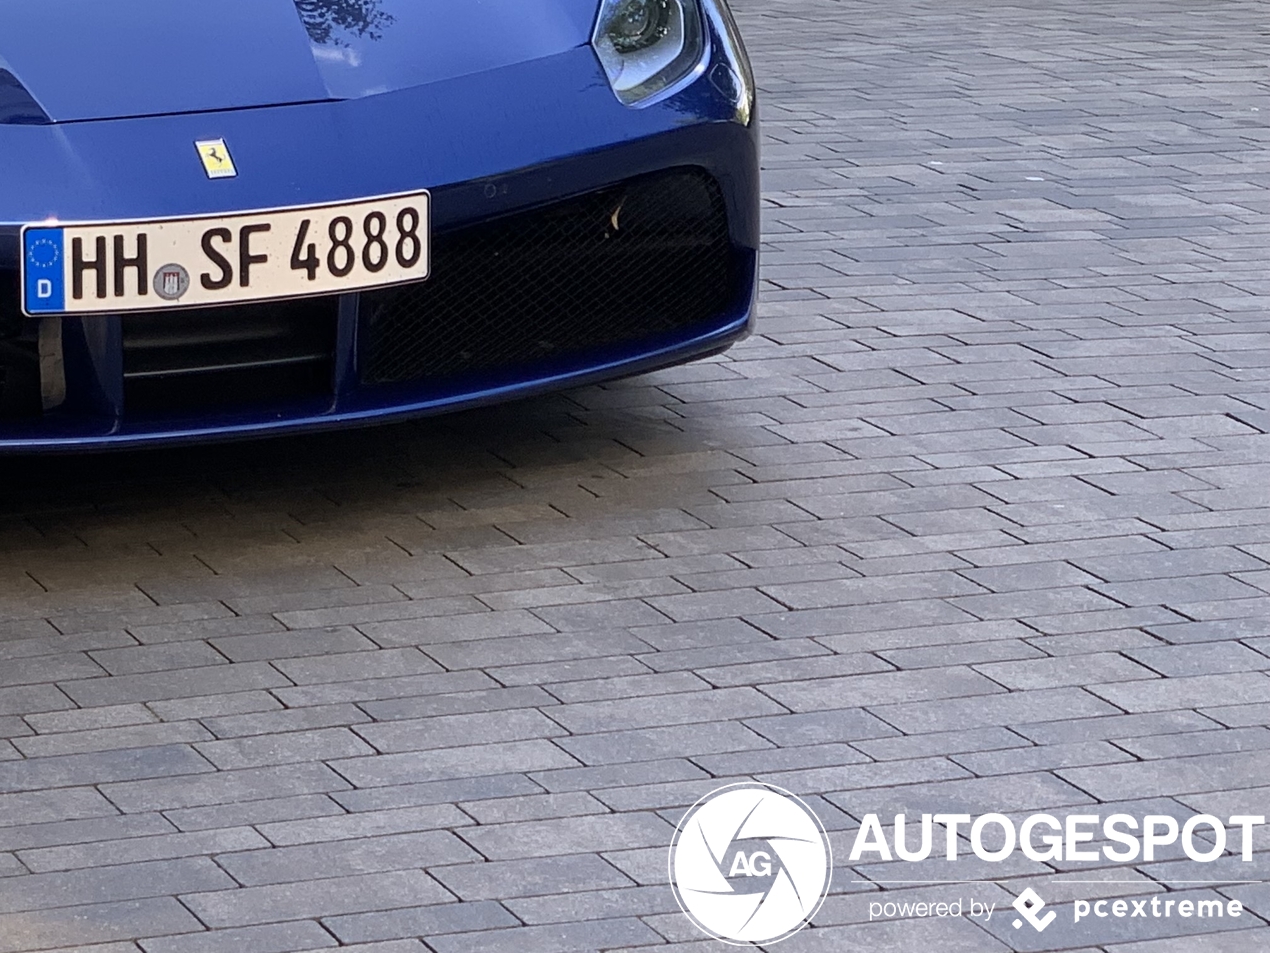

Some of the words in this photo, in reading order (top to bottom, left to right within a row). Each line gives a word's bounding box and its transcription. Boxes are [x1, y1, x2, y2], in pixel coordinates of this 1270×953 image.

[37, 279, 52, 298] D
[72, 233, 148, 300] HH
[200, 223, 271, 290] SF
[290, 207, 421, 281] 4888
